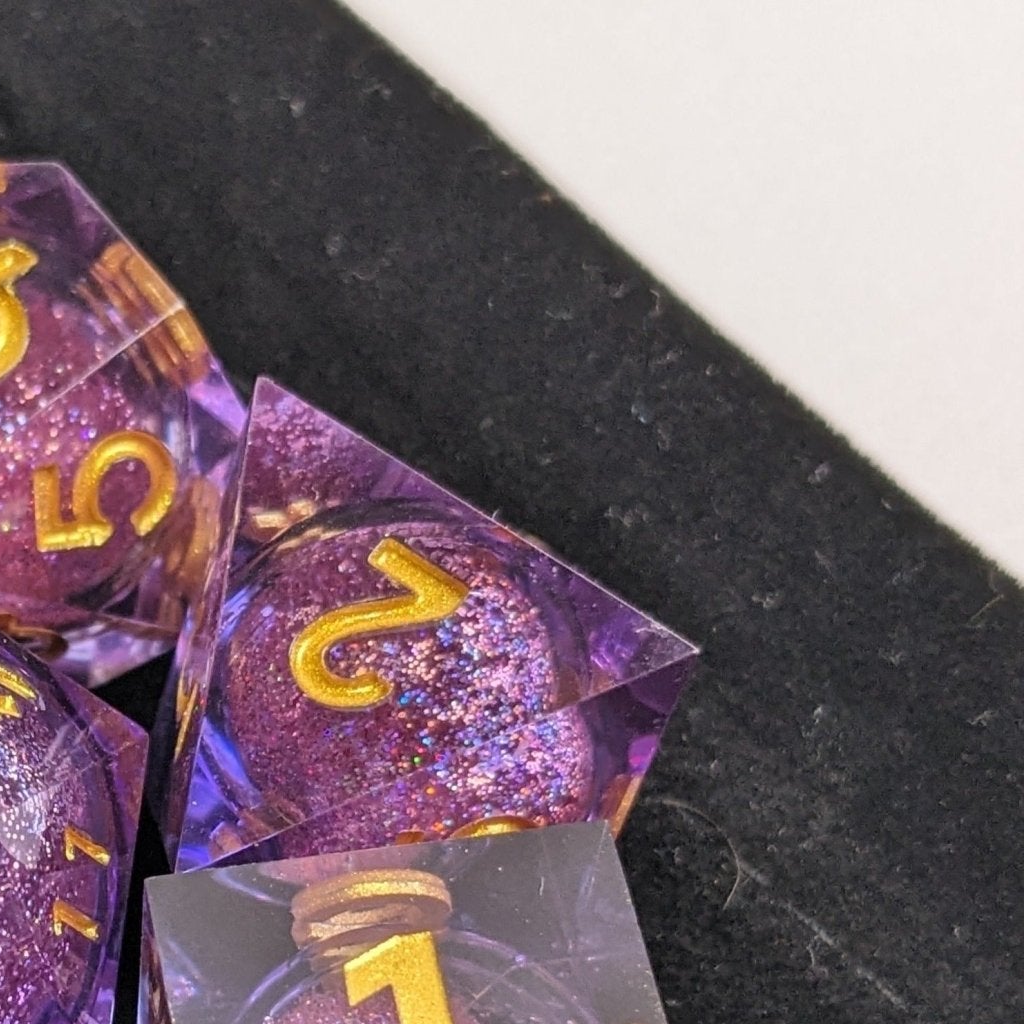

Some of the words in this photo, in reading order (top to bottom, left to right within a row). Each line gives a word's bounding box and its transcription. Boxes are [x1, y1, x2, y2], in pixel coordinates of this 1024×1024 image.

[33, 430, 176, 553] 5
[290, 537, 469, 711] 2
[53, 825, 111, 943] 11
